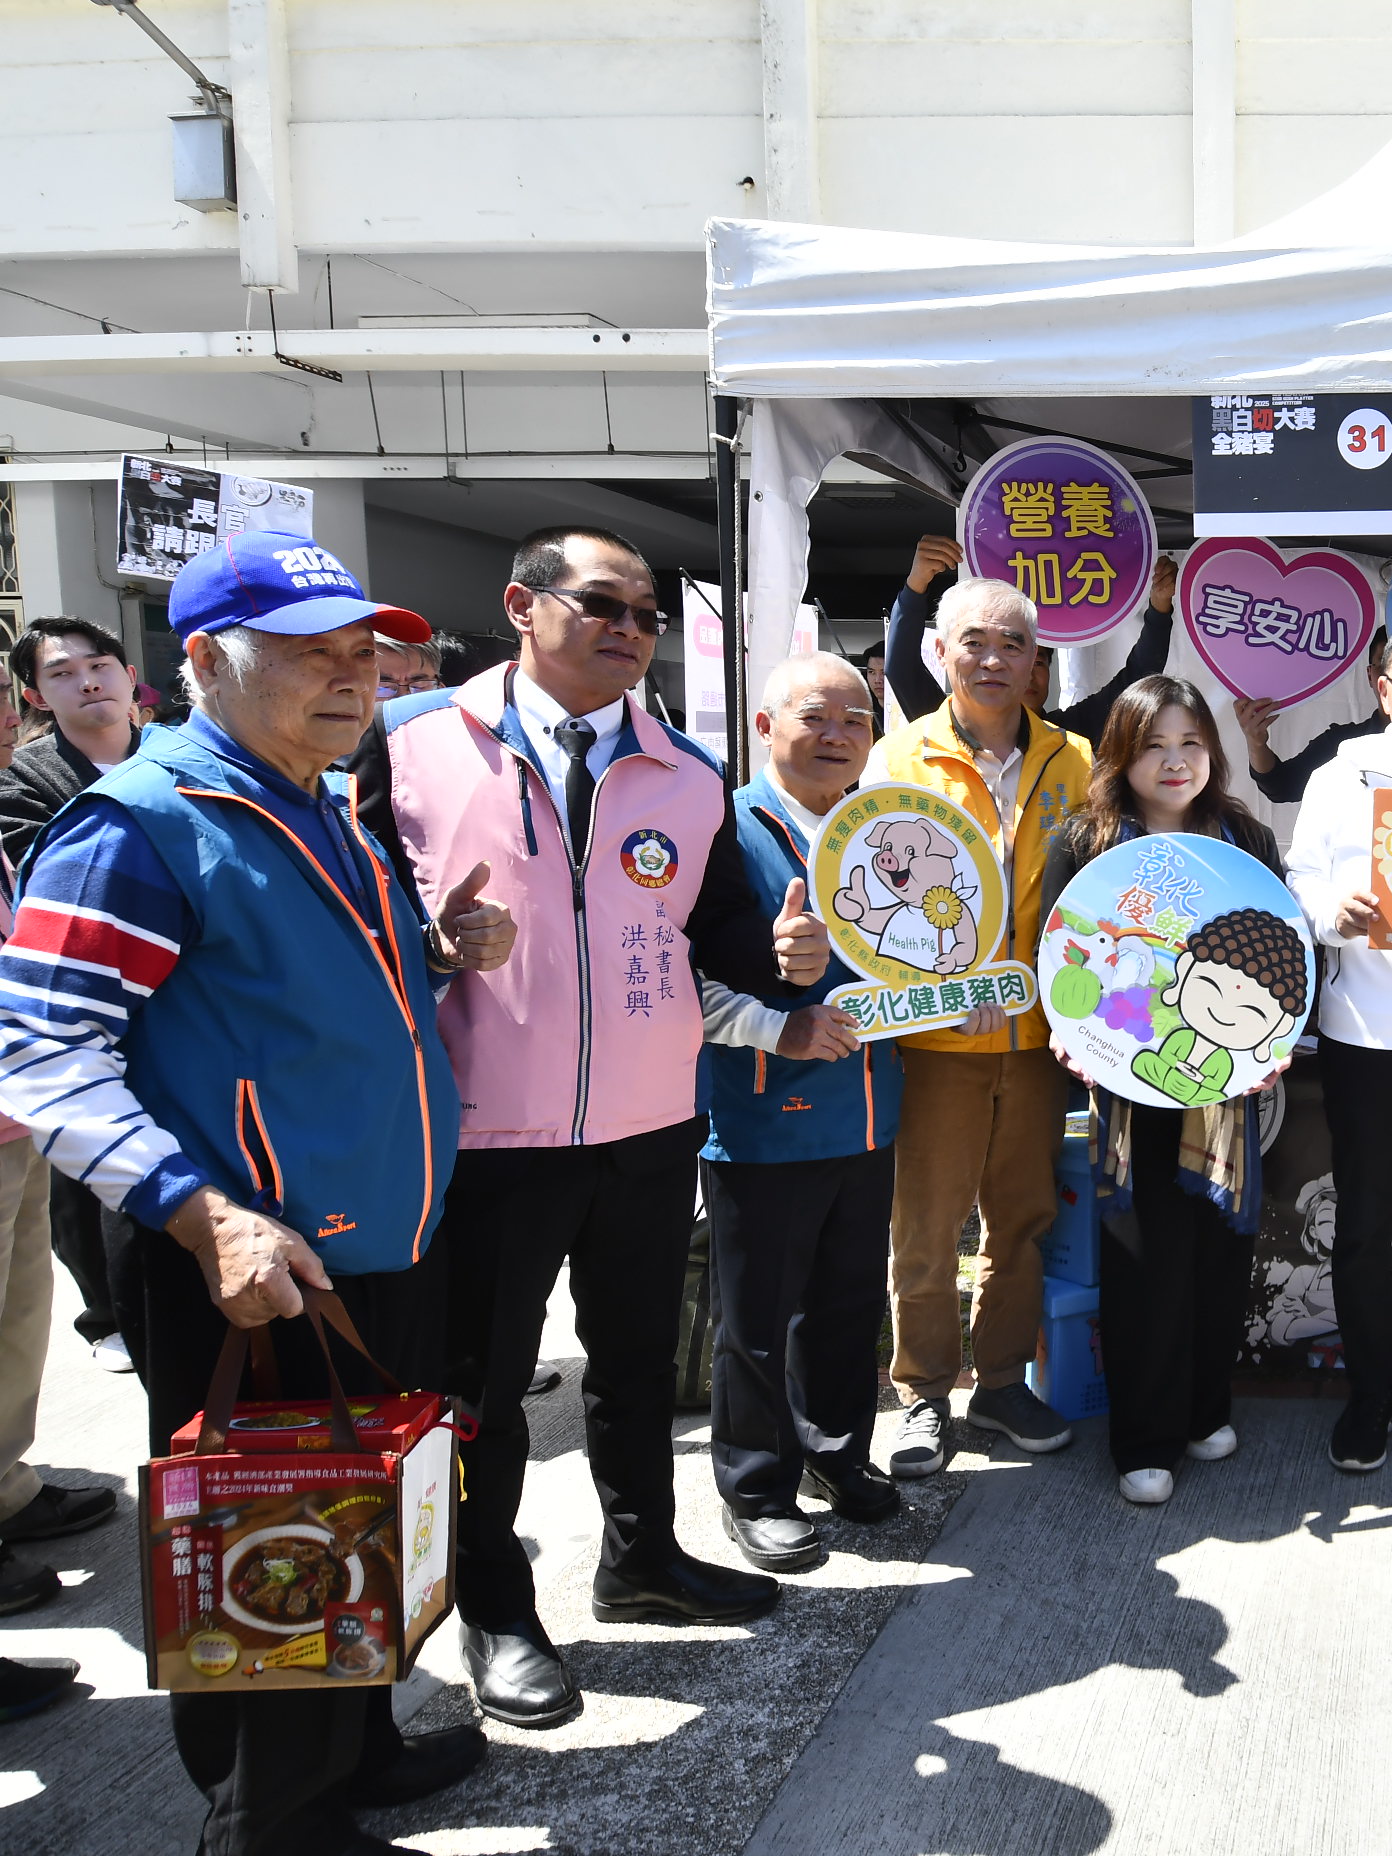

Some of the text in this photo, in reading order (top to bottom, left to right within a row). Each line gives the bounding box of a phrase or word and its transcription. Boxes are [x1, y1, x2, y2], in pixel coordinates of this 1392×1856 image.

[1211, 407, 1316, 431] 黑白切大賽
[1211, 431, 1275, 455] 全豬宴
[1347, 424, 1386, 454] 31
[188, 498, 250, 531] 長官
[1002, 481, 1114, 538] 營養
[152, 524, 227, 553] 請跟
[1008, 551, 1117, 606] 加分
[1201, 587, 1349, 660] 享安心
[639, 830, 667, 844] 新北市
[1115, 886, 1193, 948] 優鮮
[889, 932, 936, 952] Health Pig
[621, 923, 653, 1018] 洪嘉興
[841, 973, 1026, 1029] 彰化健康豬肉
[1077, 1025, 1125, 1059] Changhua
[1086, 1043, 1119, 1069] County
[170, 1537, 192, 1577] 藥膳
